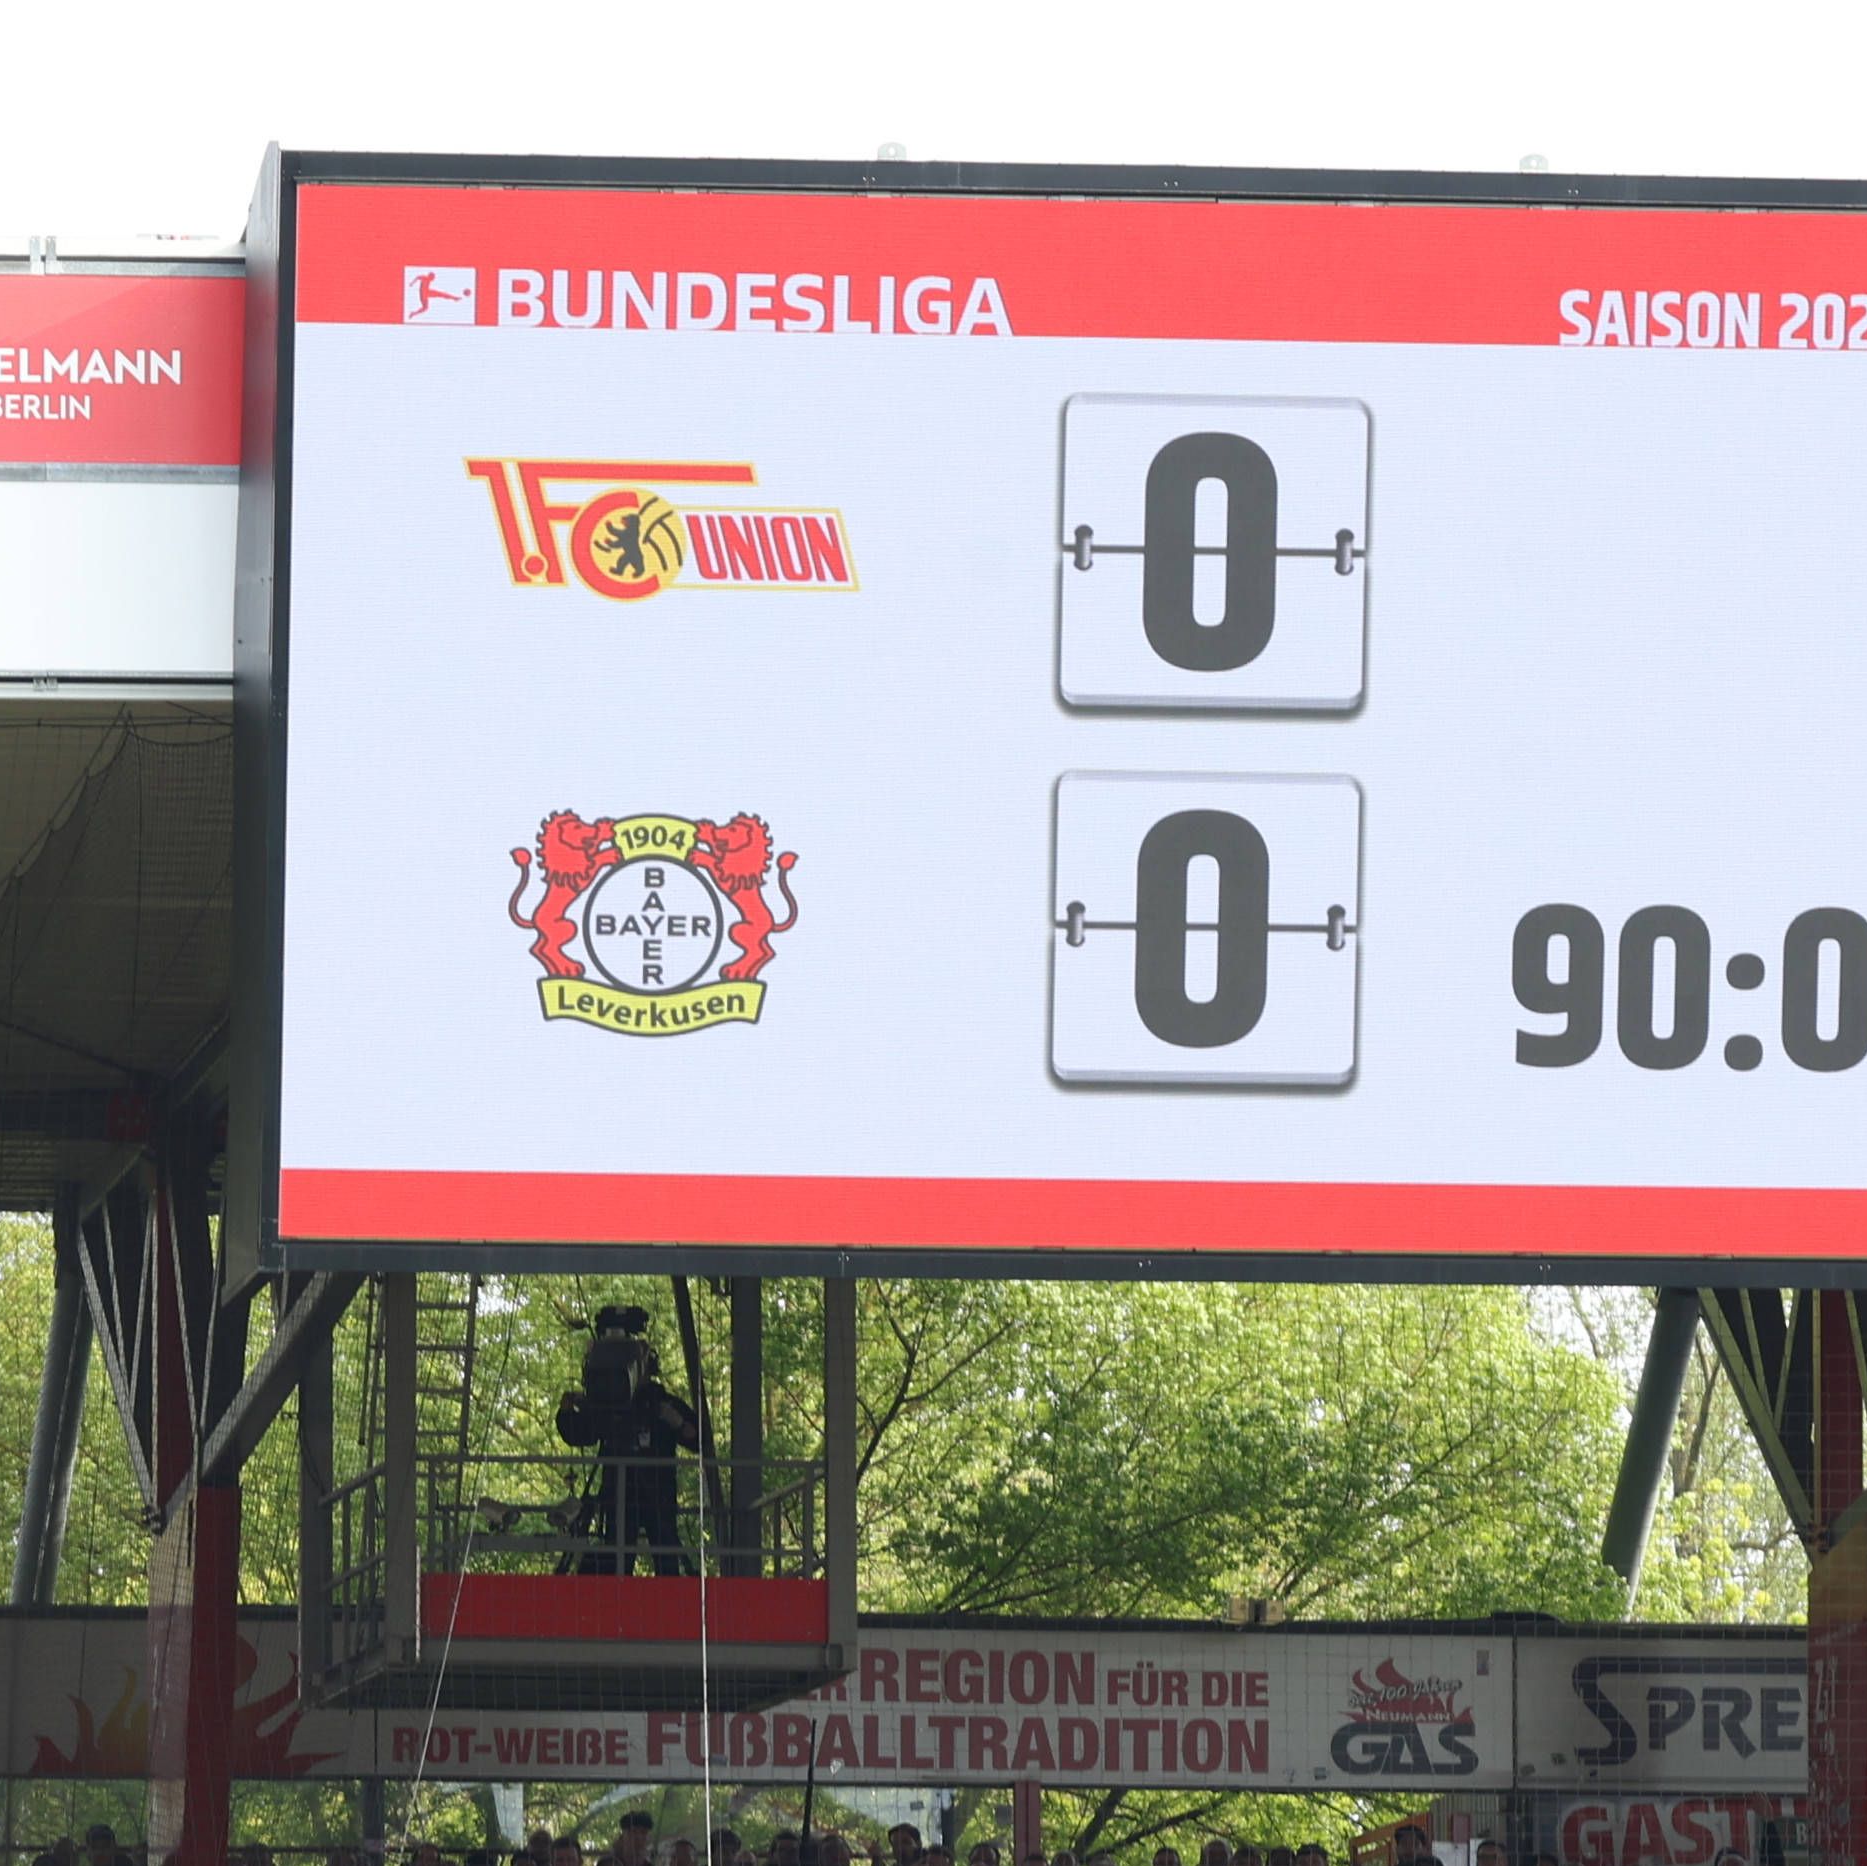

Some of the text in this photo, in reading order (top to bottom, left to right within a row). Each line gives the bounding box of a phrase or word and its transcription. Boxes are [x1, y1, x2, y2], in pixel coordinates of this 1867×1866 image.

[496, 267, 1014, 337] BUNDESLIGA
[1558, 289, 1762, 350] SAISON
[685, 513, 850, 583] UNION
[1142, 431, 1279, 672] 0
[620, 825, 687, 851] 1904
[595, 914, 712, 937] BAYER
[641, 866, 665, 985] BAYER
[1133, 807, 1270, 1049] 0
[557, 986, 746, 1028] Leverkusen
[858, 1649, 1096, 1706] REGION
[1107, 1661, 1190, 1707] FÜR
[1210, 1671, 1269, 1707] DIE
[1365, 1709, 1451, 1722] NEUMANN
[1572, 1656, 1808, 1766] SPRE
[1330, 1721, 1480, 1776] GAS
